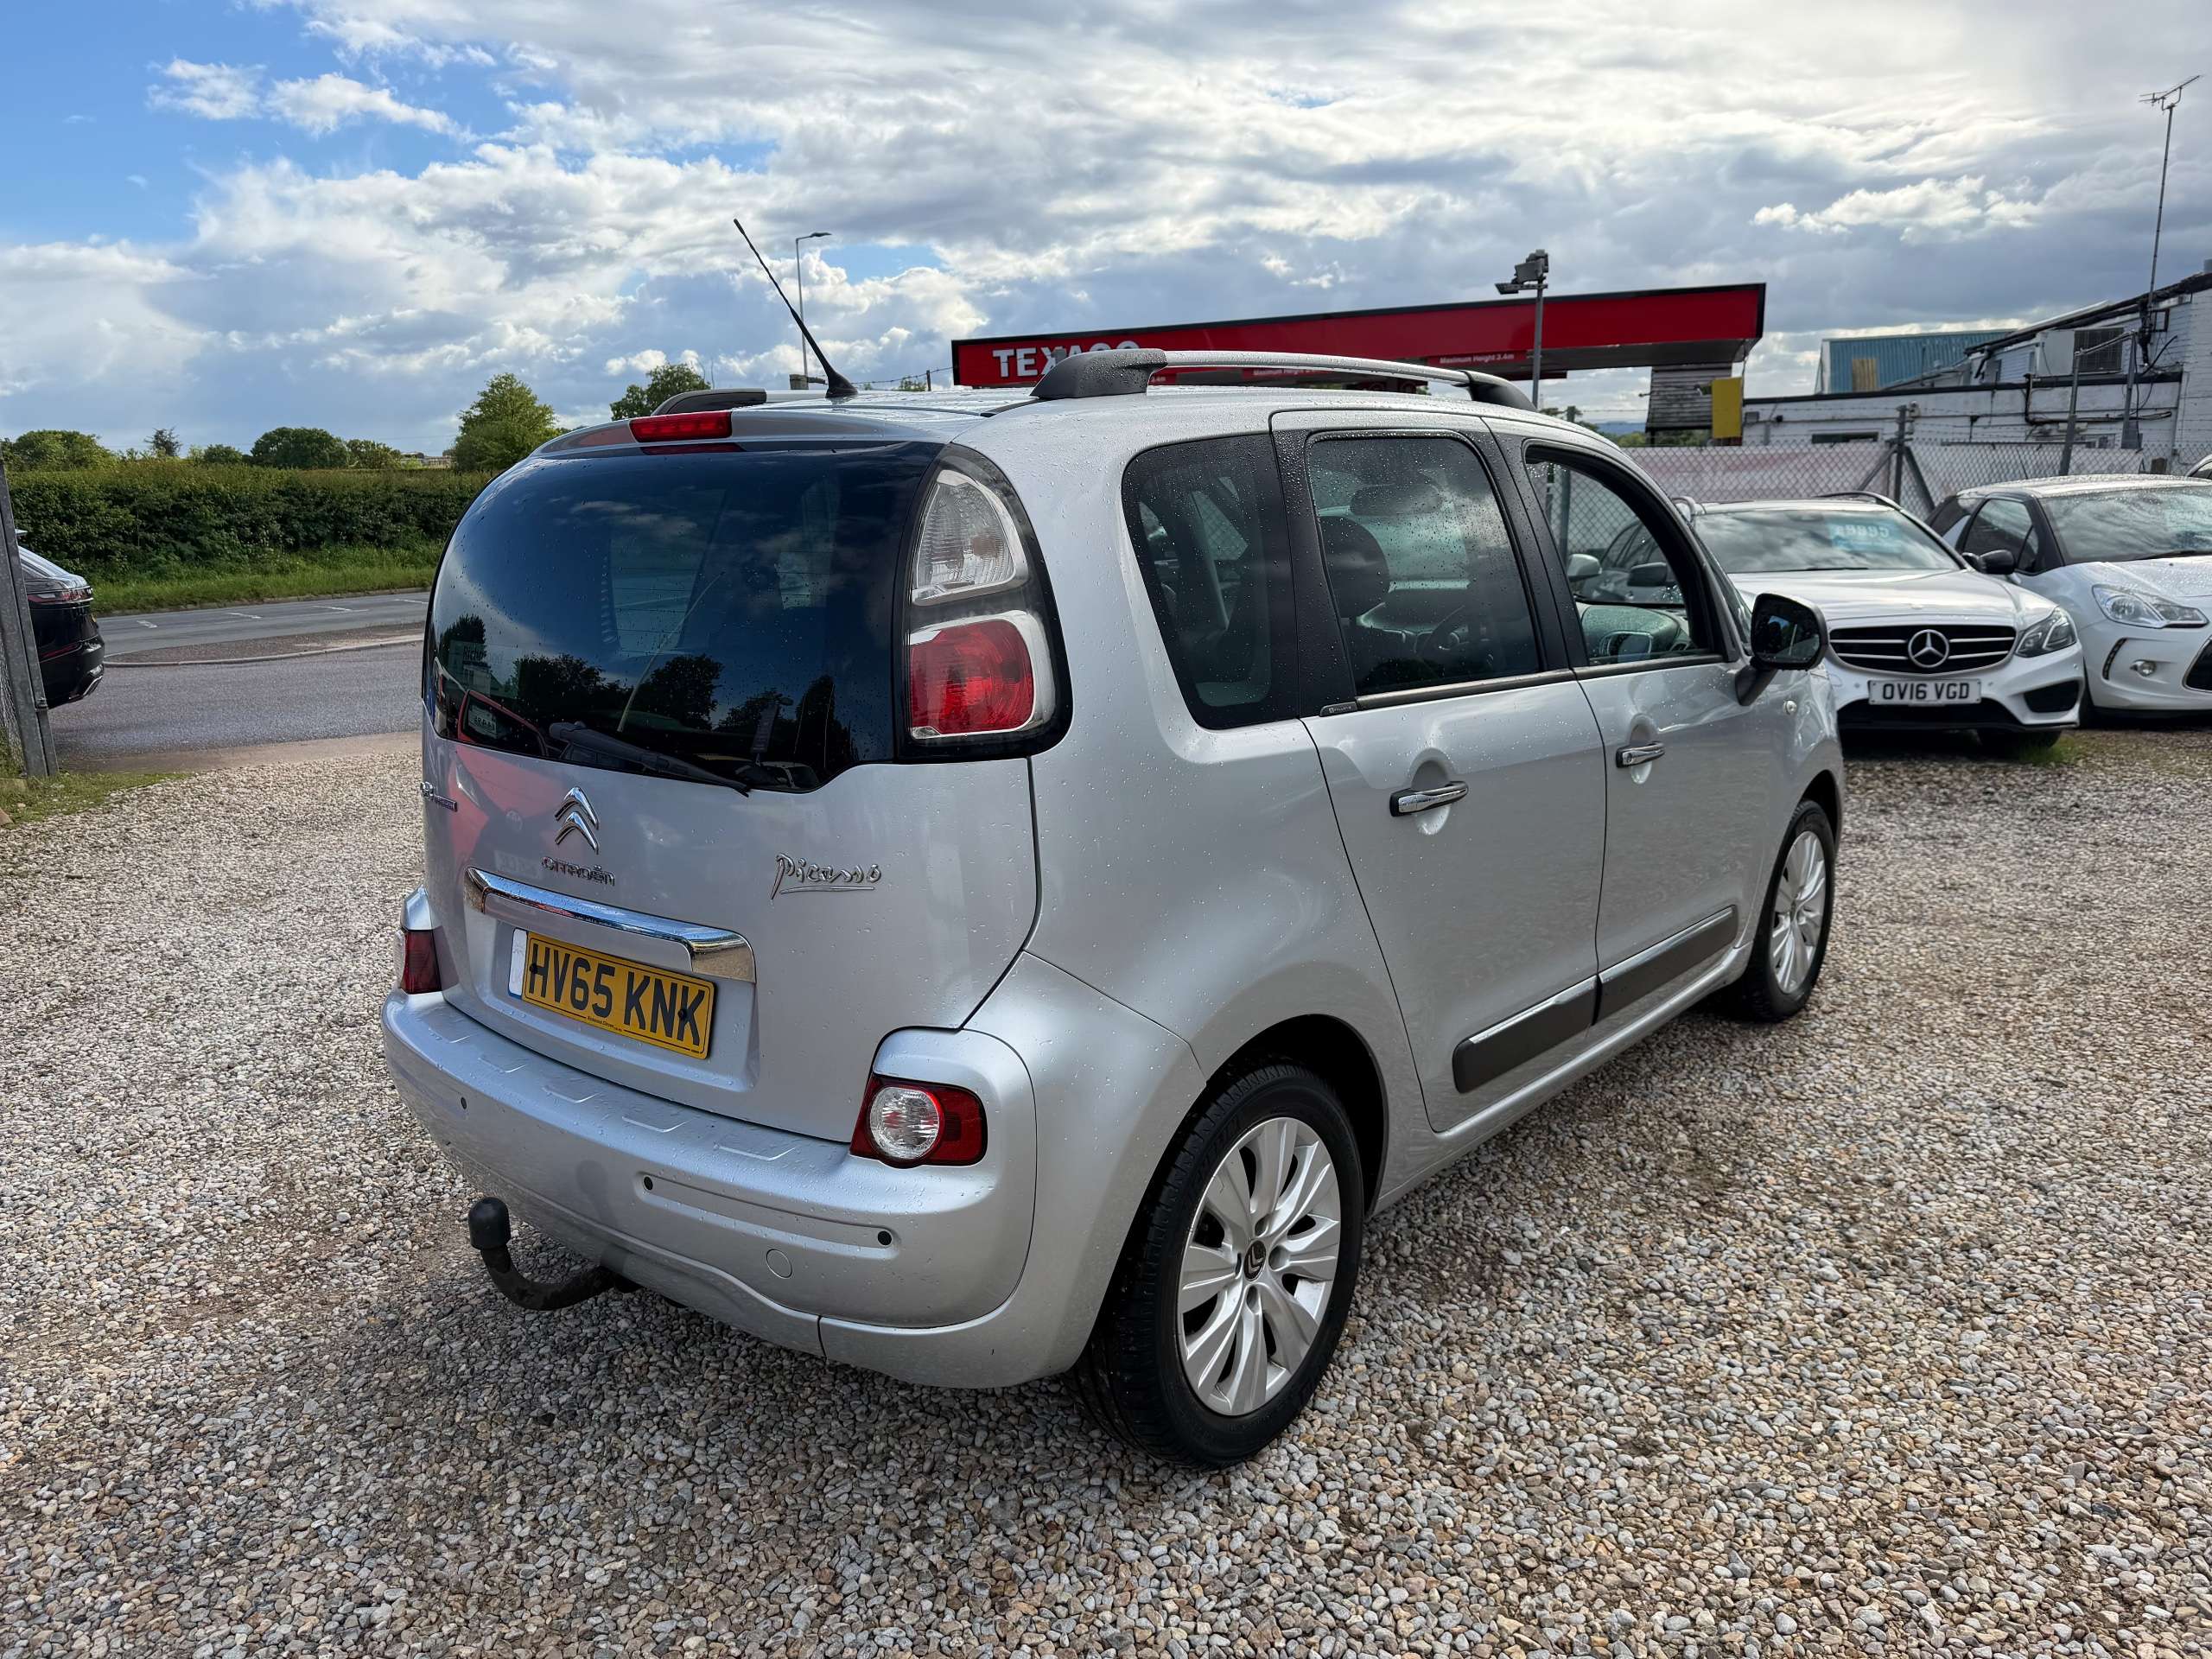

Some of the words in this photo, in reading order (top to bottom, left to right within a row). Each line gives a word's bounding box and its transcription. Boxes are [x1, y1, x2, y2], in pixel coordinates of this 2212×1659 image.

[992, 340, 1140, 378] TEX
[1440, 355, 1471, 364] Maximum
[1472, 354, 1496, 363] Height
[1882, 683, 1929, 701] OV16
[1935, 682, 1970, 700] VGD
[770, 852, 882, 900] Picasso
[529, 944, 615, 1019] HV65
[623, 970, 706, 1046] KNK
